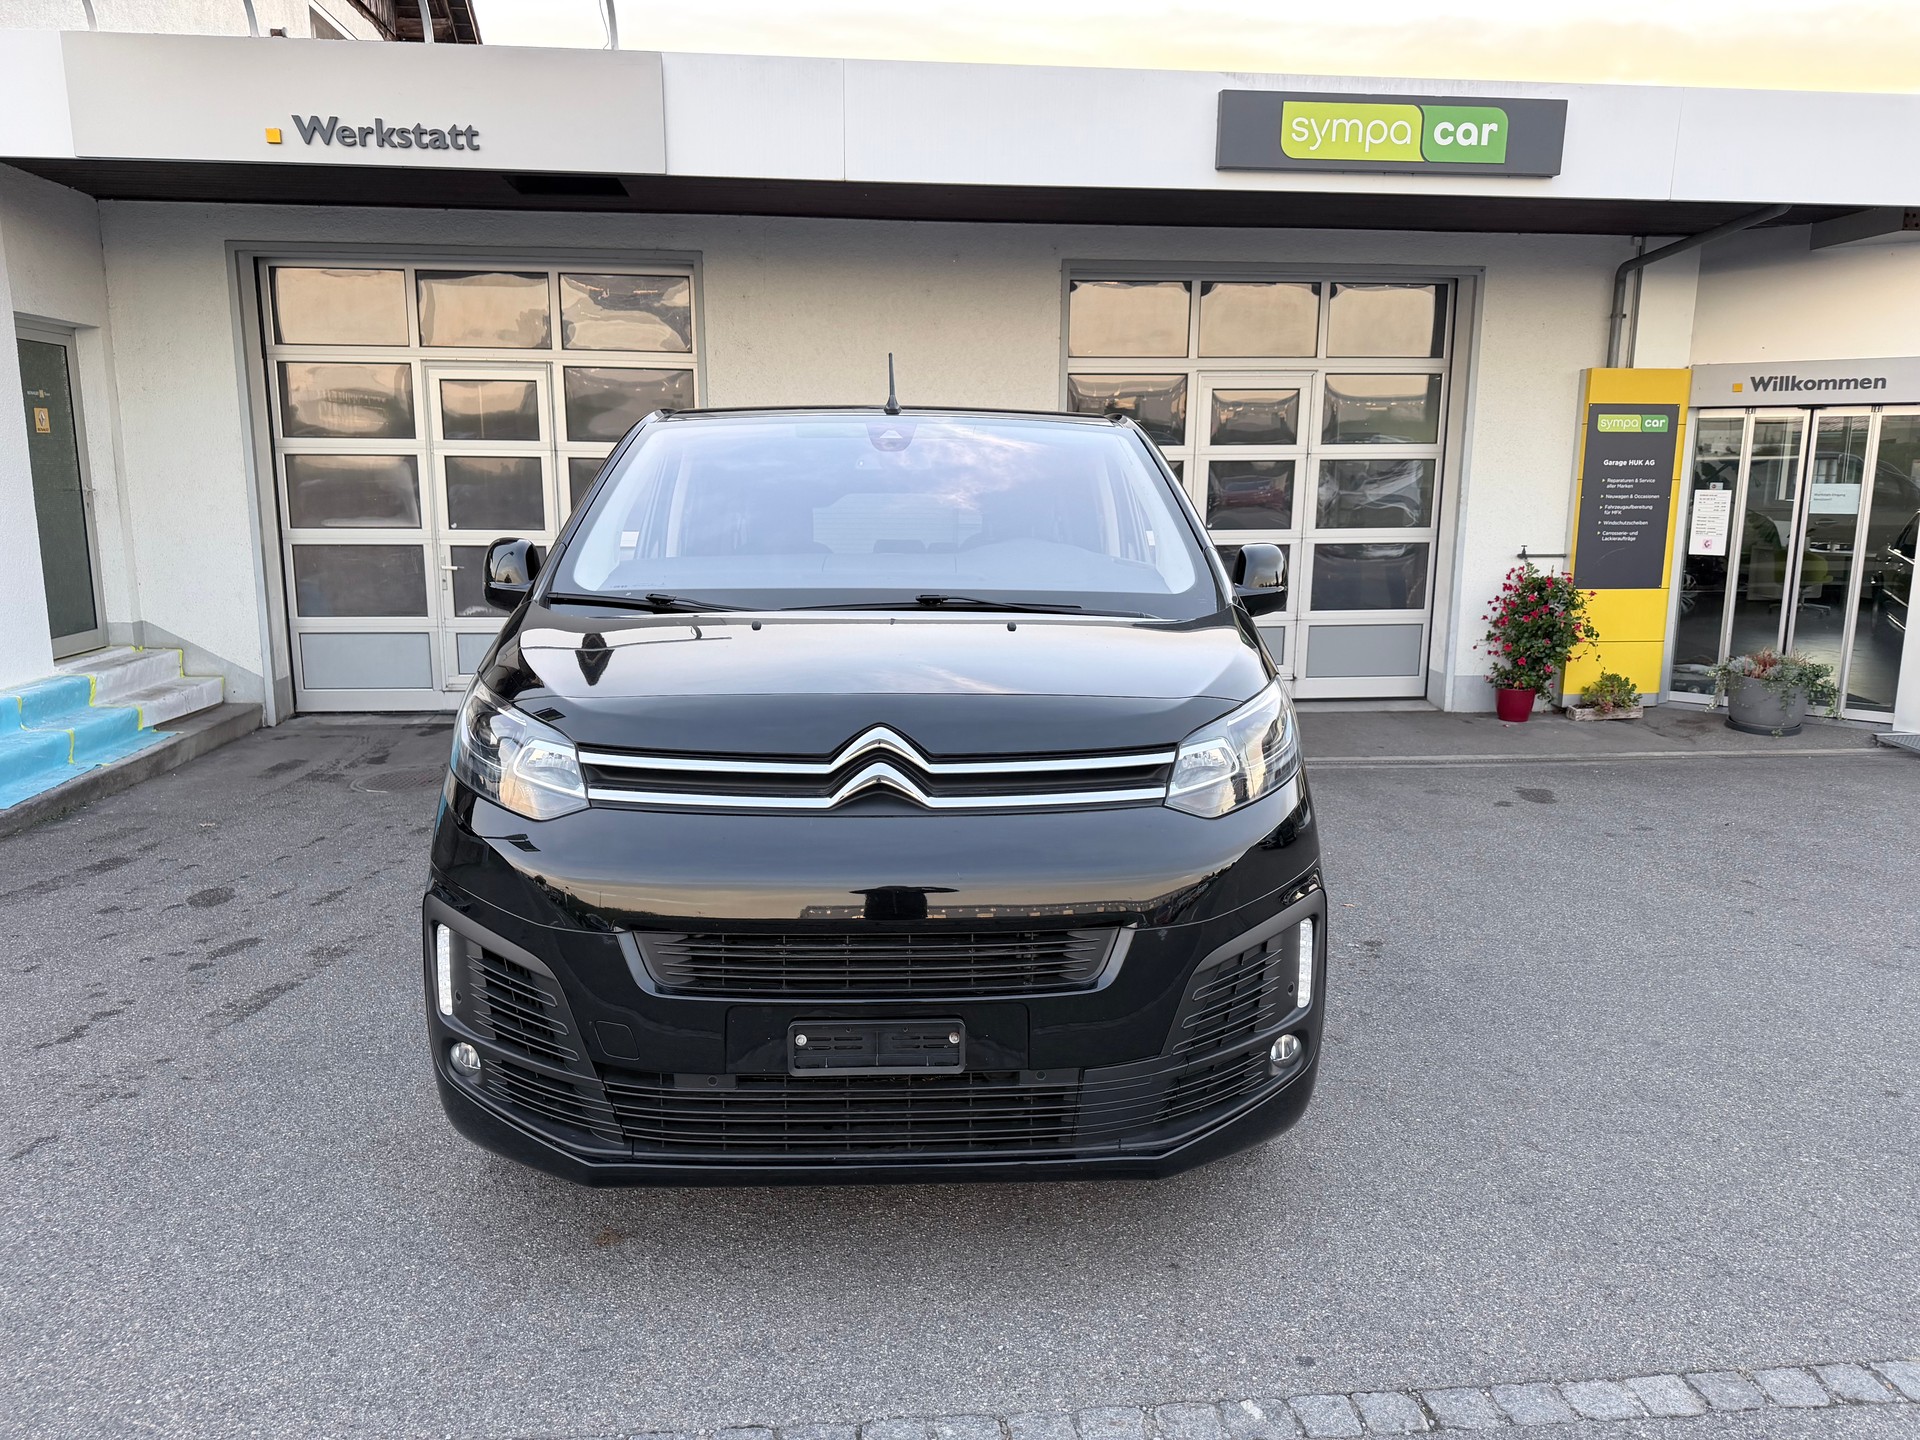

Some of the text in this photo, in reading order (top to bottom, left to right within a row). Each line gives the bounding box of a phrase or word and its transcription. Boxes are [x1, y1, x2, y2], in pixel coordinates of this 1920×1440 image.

[291, 114, 480, 151] Werkstatt
[1290, 116, 1499, 153] sympa car
[1750, 375, 1887, 392] Willkommen
[1600, 418, 1666, 430] sympa car
[1603, 459, 1628, 467] Garage
